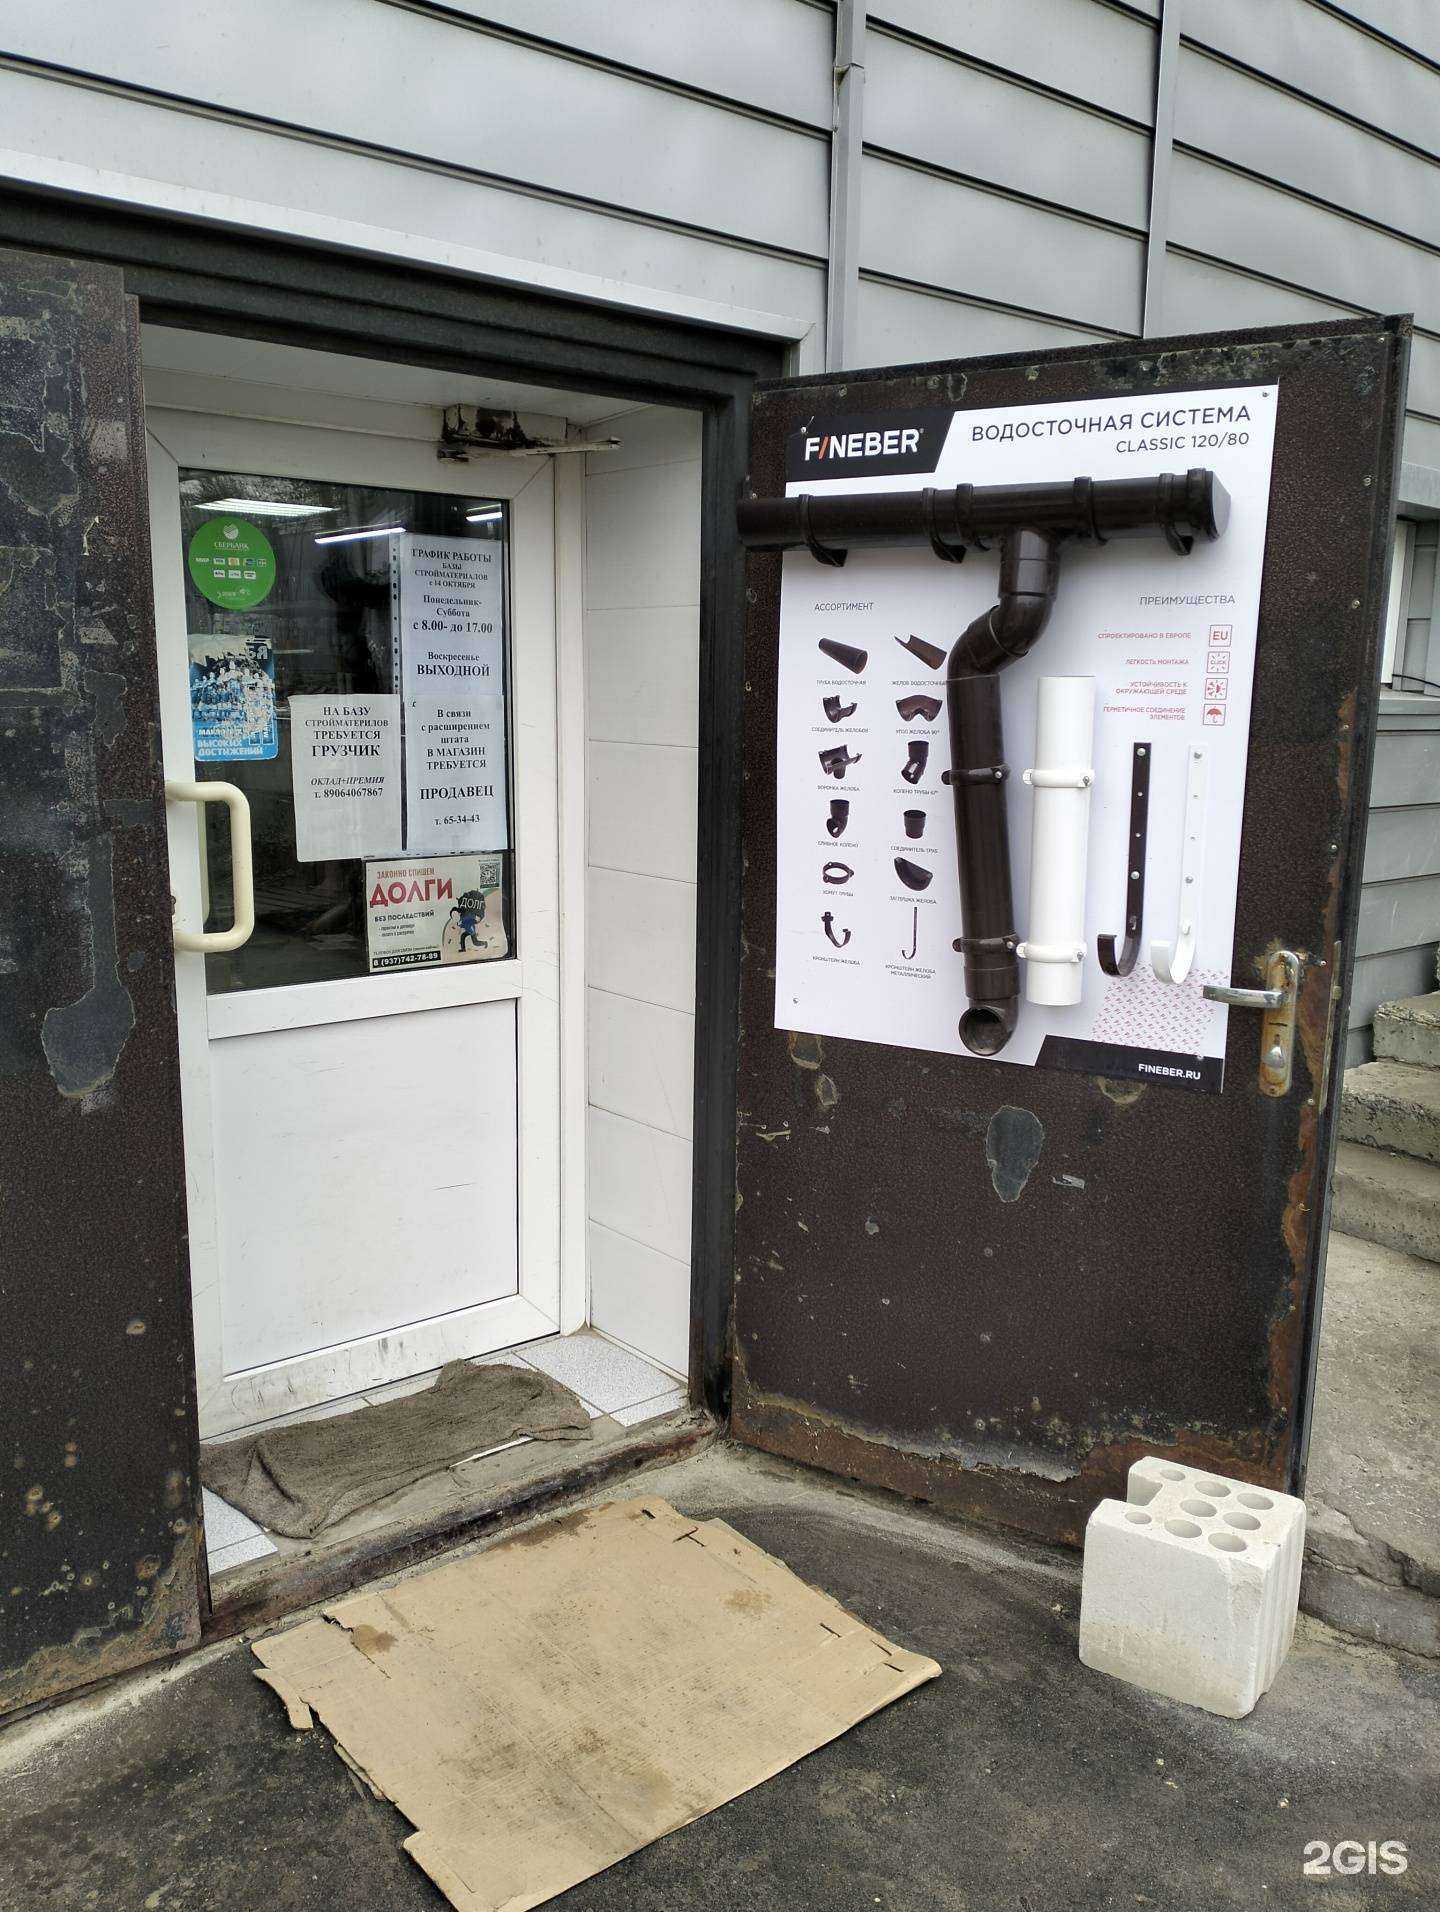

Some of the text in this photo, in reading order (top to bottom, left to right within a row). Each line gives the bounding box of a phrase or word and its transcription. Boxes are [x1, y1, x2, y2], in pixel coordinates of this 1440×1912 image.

[972, 405, 1251, 442] ВОДОСТОЧНАЯ СИСТЕМА
[1116, 432, 1250, 454] CLASSIC 120/80
[214, 541, 249, 550] СБЕРБАНК
[412, 548, 491, 562] ГРАФИК РАБОТЫ
[442, 562, 462, 570] БАЗЫ
[415, 569, 488, 580] СТРОЙМАТЕРИАЛОВ
[423, 595, 482, 606] Понедельник-
[1139, 595, 1236, 606] ПРЕИМУЩЕСТВА
[814, 602, 874, 611] АССОРТИМЕНТ
[436, 608, 470, 618] Суббота
[413, 622, 419, 630] с
[450, 624, 463, 633] до
[466, 622, 493, 633] 17.00
[1213, 631, 1229, 641] EU
[428, 652, 480, 662] Воскресенье
[417, 664, 490, 677] ВЫХОДНОЙ
[1115, 687, 1165, 695] ОКРУЖАЮЩЕЙ
[323, 706, 371, 716] НА БАЗУ
[437, 709, 471, 718] В связи
[305, 718, 389, 727] СТРОЙМАТЕРИЛОВ
[421, 723, 490, 733] с расширением
[314, 730, 380, 740] ТРЕБУЕТСЯ
[441, 736, 469, 744] штата
[198, 746, 263, 756] ДОСТИЖЕНИЙ
[312, 744, 380, 757] ГРУЗЧИК
[427, 746, 485, 757] В МАГАЗИН
[426, 760, 487, 770] ТРЕБУЕТСЯ
[310, 777, 385, 786] ОКЛАД+ПРЕМИЯ
[323, 787, 383, 798] 89064067867
[420, 785, 494, 800] ПРОДАВЕЦ
[443, 814, 480, 825] 65-34-43
[377, 867, 435, 880] ЗАКОННО СПИШЕМ
[369, 878, 453, 908] ДОЛГИ
[460, 897, 482, 909] ДОЛГ
[374, 910, 435, 922] БЕЗ ПОСЛЕДСТВИЙ
[1138, 1063, 1201, 1080] FINEBER.RU
